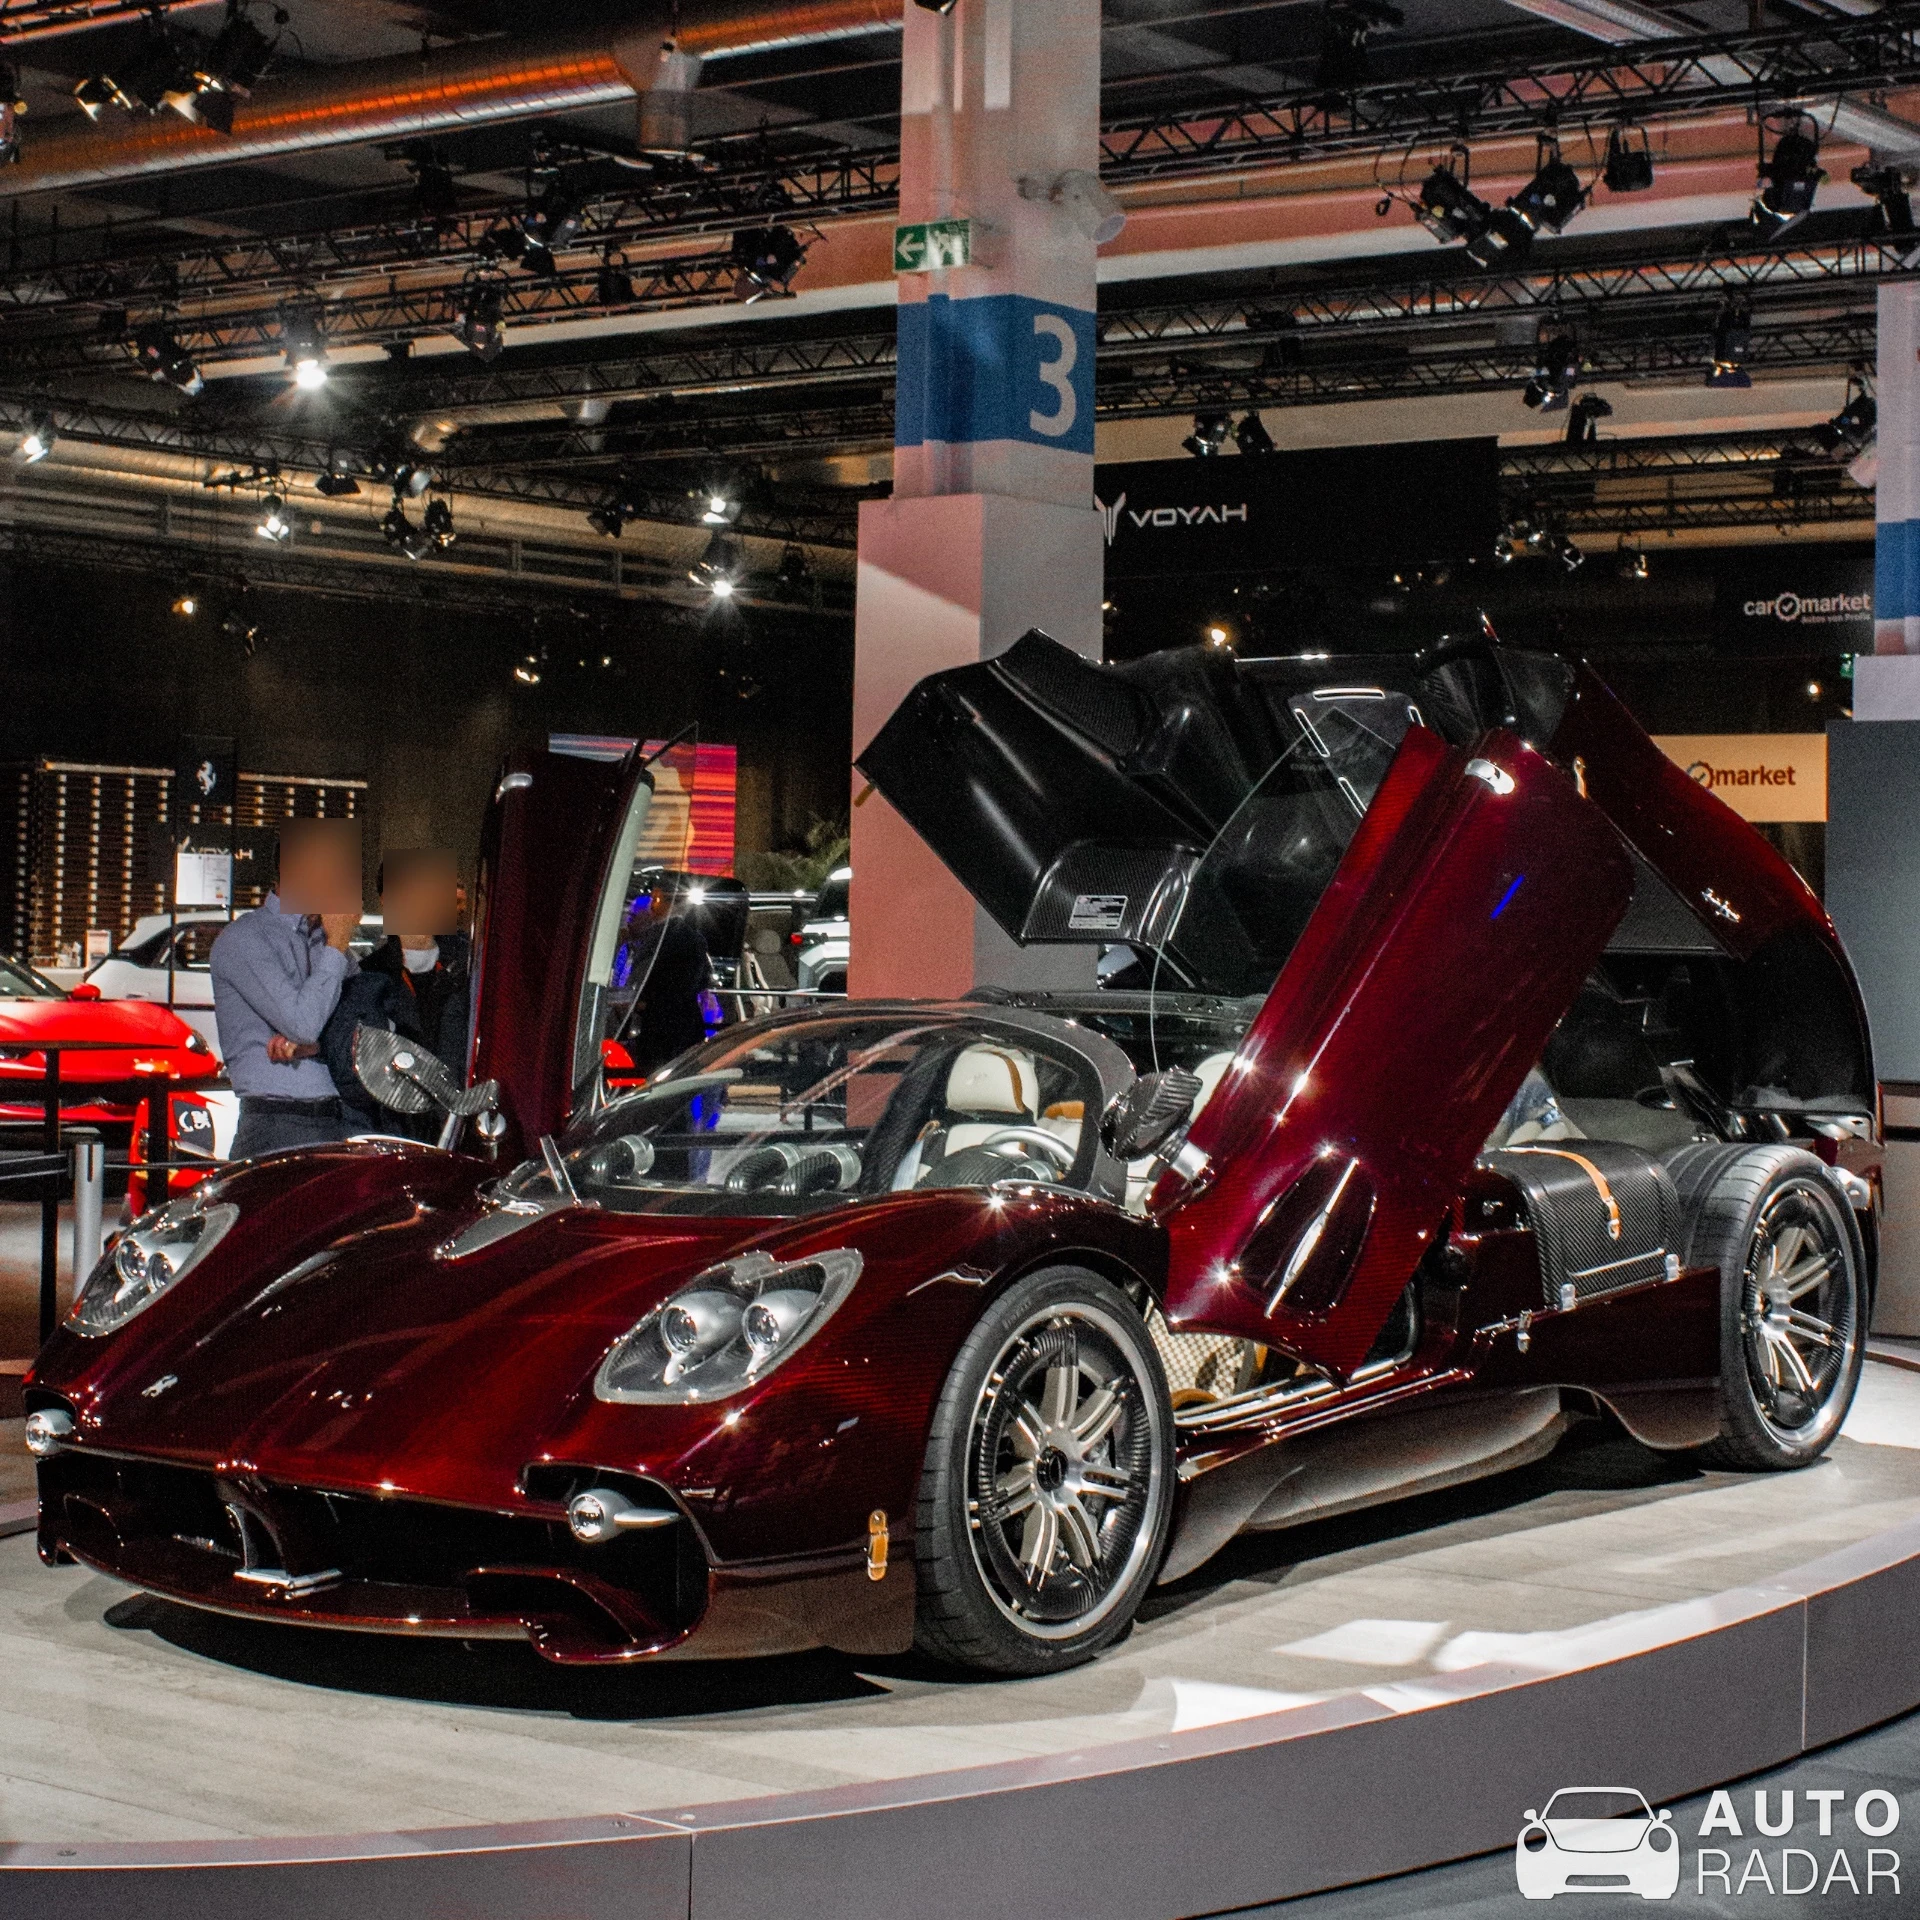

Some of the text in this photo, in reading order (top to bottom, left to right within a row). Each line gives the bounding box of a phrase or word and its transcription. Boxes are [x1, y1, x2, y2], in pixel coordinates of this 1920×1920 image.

[1029, 314, 1078, 437] 3
[1128, 503, 1248, 528] VOYAH
[1715, 765, 1797, 786] market
